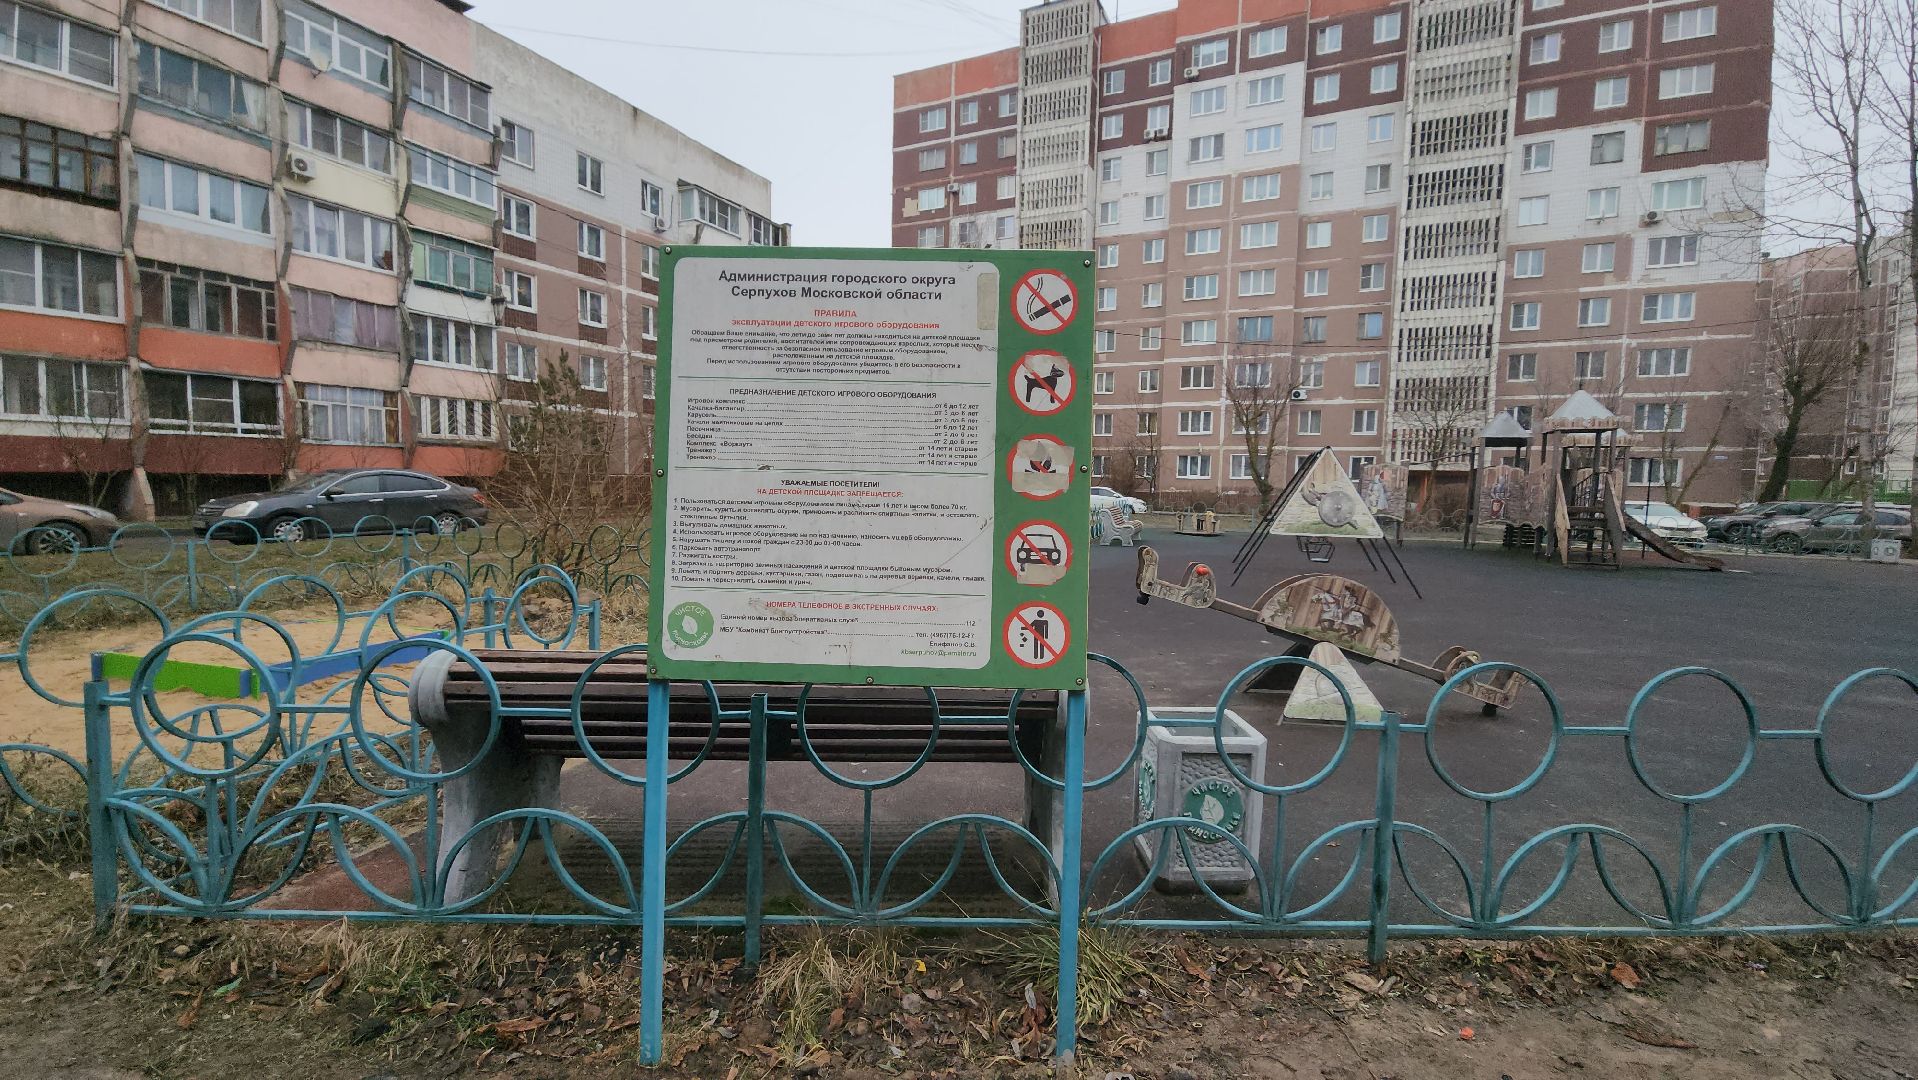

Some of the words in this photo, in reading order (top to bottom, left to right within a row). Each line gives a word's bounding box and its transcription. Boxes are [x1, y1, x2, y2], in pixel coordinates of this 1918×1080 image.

[718, 270, 827, 284] Администрация
[831, 274, 907, 286] городского
[911, 275, 955, 287] округа
[731, 285, 796, 300] Серпухов
[800, 286, 882, 299] Московской
[886, 288, 941, 300] области
[814, 309, 857, 317] ПРАВИЛА
[731, 319, 791, 327] эксплуатации
[792, 320, 831, 328] детского
[876, 321, 939, 330] оборудования
[729, 388, 796, 396] ПРЕДНАЗНАЧЕНИЕ
[797, 389, 835, 397] ДЕТСКОГО
[876, 391, 936, 399] ОБОРУДОВАНИЯ
[674, 605, 706, 617] ЧИСТОЕ
[797, 601, 843, 609] ТЕЛЕФОНОВ
[851, 603, 900, 611] ЭКСТРЕННЫХ
[1191, 781, 1236, 800] ЧИСТОЕ
